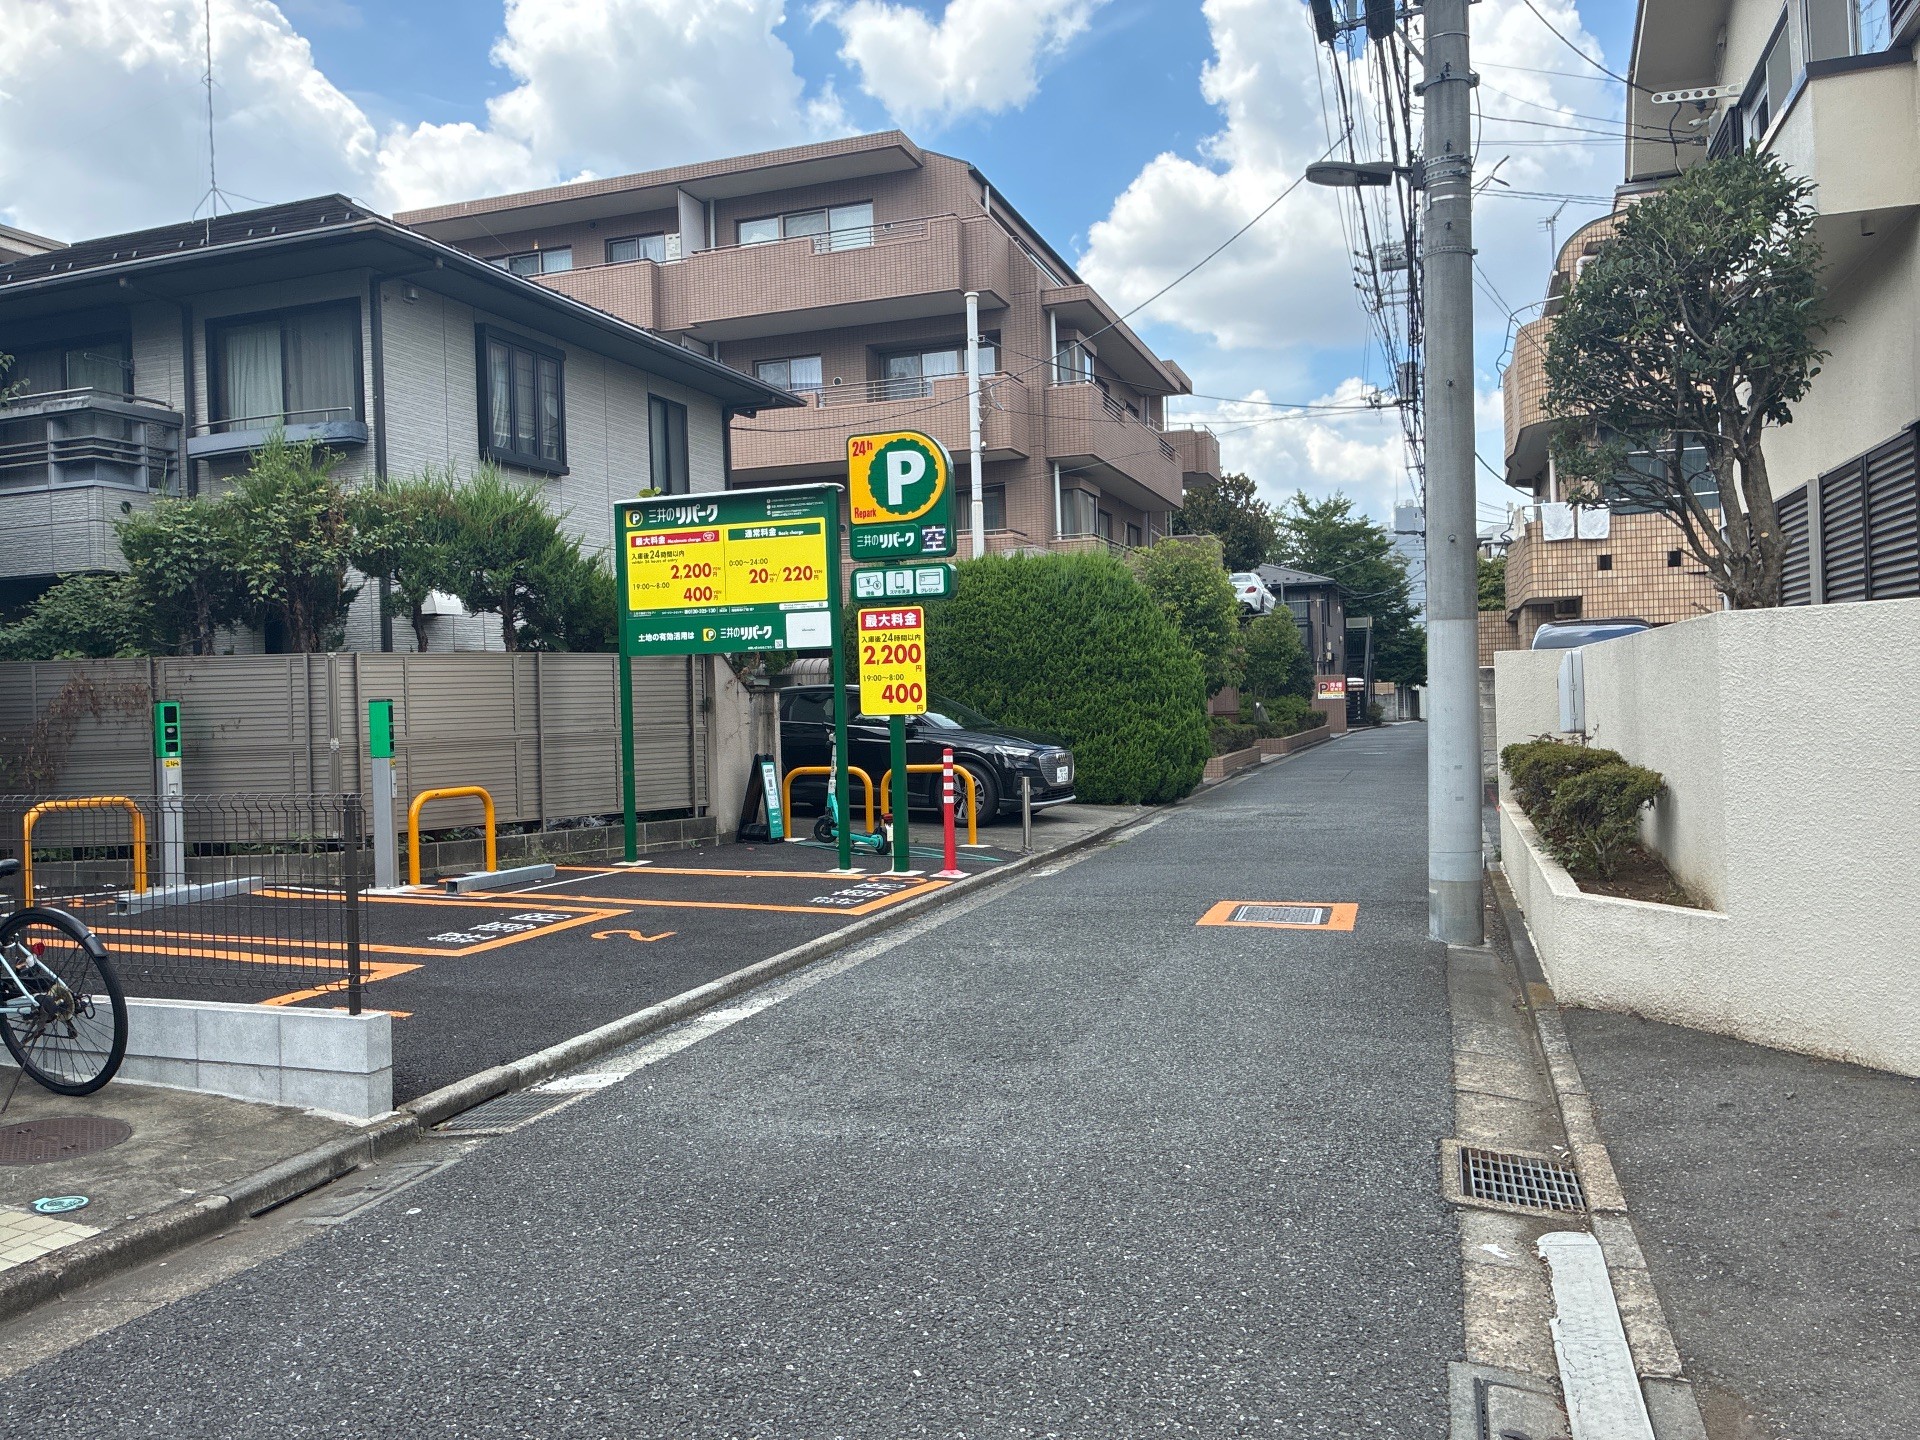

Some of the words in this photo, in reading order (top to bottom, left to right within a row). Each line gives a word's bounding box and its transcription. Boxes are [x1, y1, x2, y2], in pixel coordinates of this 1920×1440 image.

[852, 440, 873, 457] 24h
[887, 450, 926, 505] P
[648, 504, 718, 525] 三井のリパーク
[854, 507, 877, 520] Repark
[635, 535, 666, 546] 最大料金
[744, 528, 776, 538] 通常料金
[856, 531, 915, 549] 三井のリパーク
[921, 526, 947, 552] 空
[670, 562, 712, 580] 2,200
[749, 568, 769, 584] 20
[783, 565, 813, 582] 220
[683, 586, 713, 602] 400
[865, 612, 917, 628] 最大料金
[638, 631, 695, 643] 土地の有効活用は
[720, 625, 773, 641] 三井のリパーク
[861, 633, 921, 643] 入庫後24時間以内
[863, 643, 922, 666] 2,200
[882, 683, 923, 703] 400
